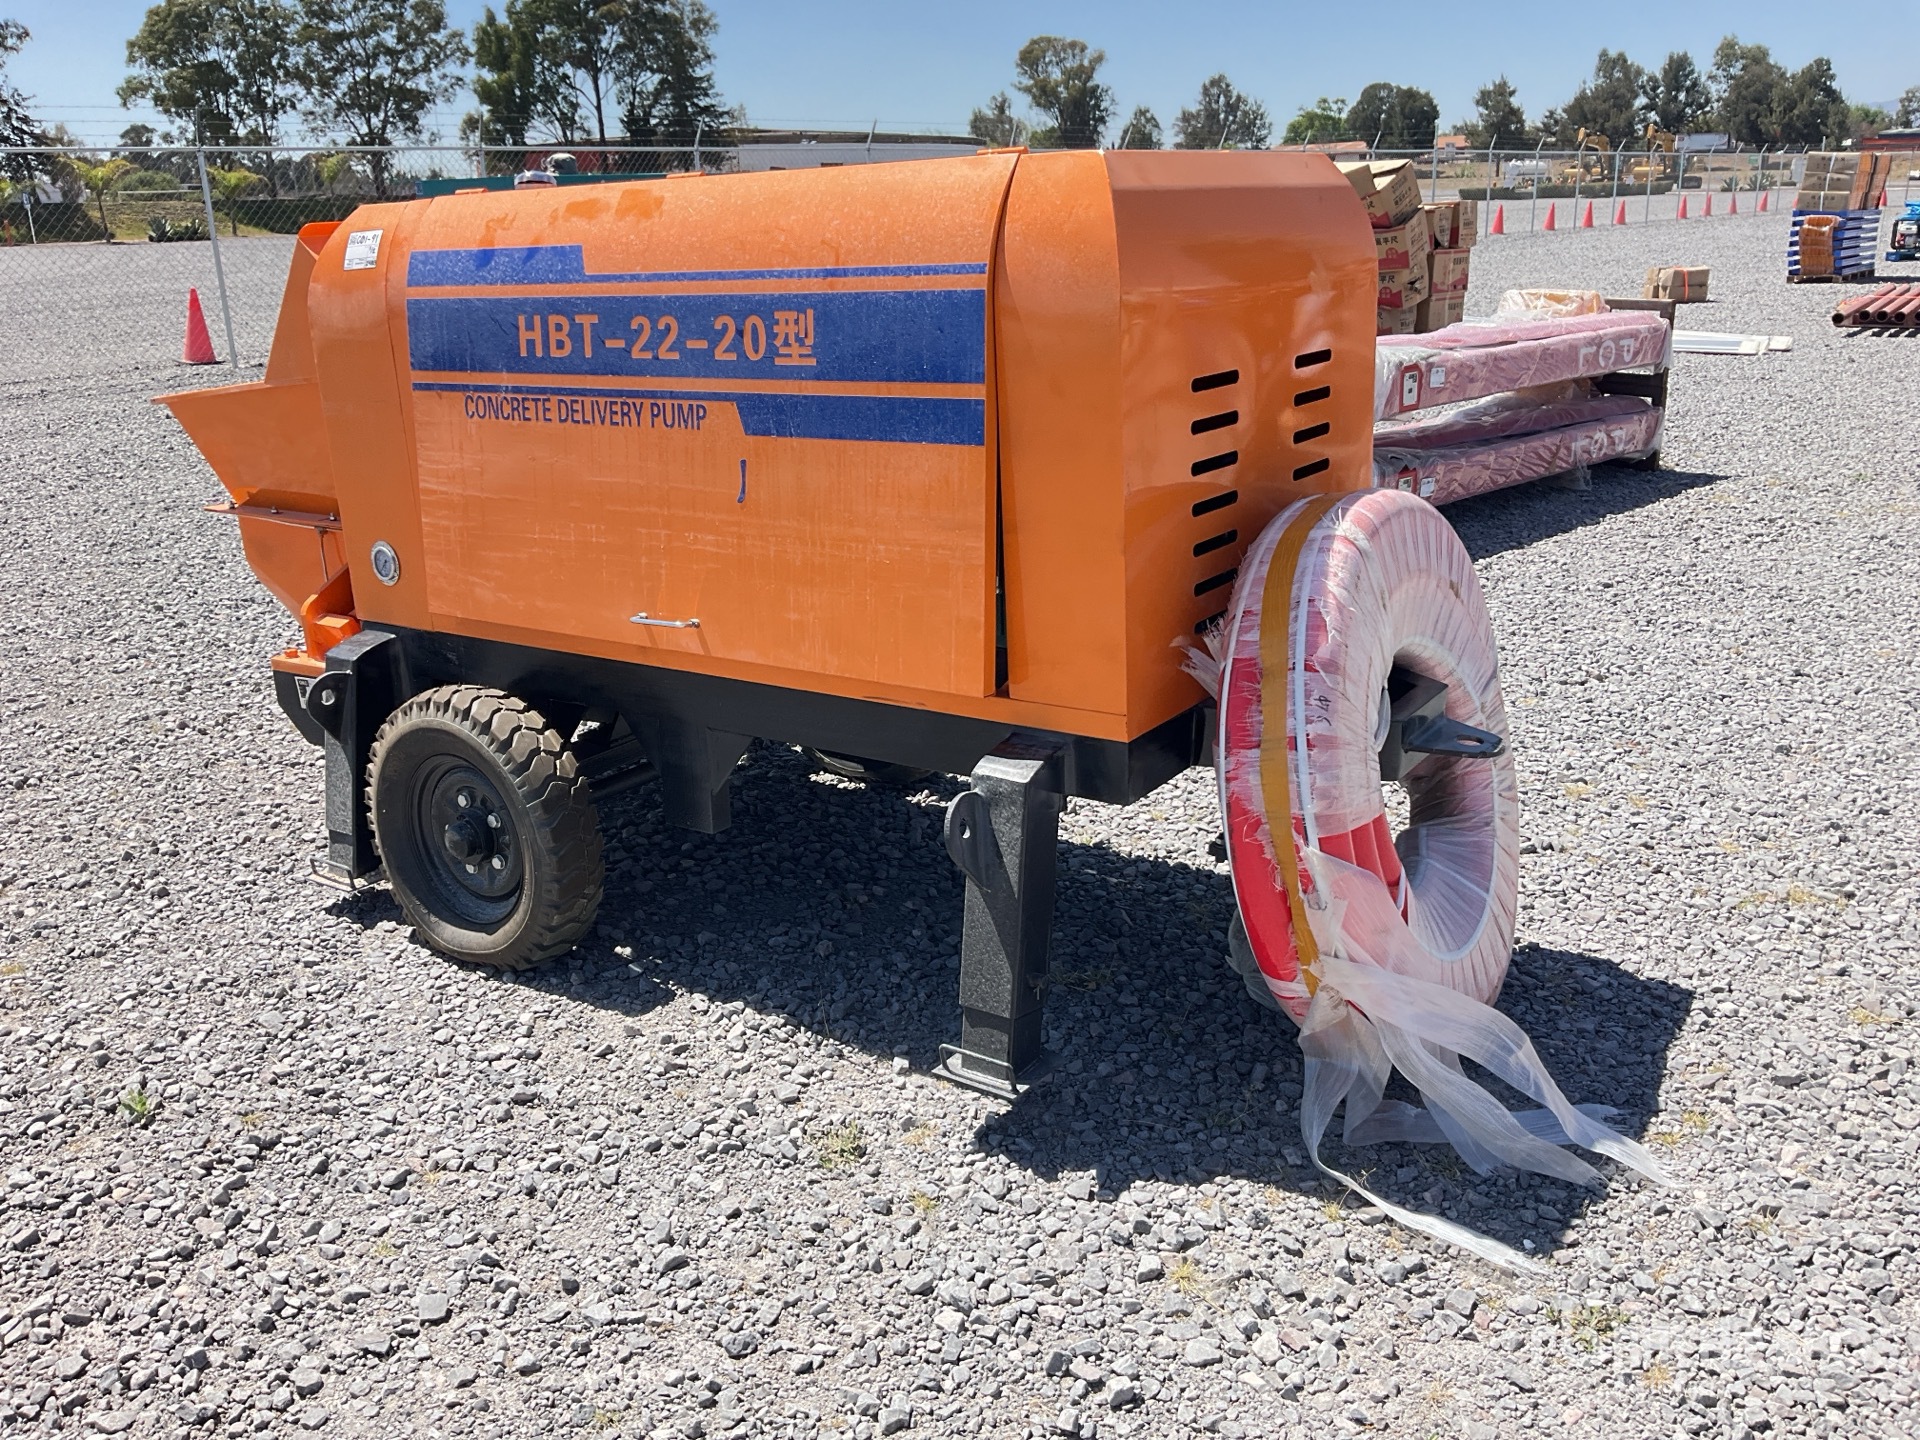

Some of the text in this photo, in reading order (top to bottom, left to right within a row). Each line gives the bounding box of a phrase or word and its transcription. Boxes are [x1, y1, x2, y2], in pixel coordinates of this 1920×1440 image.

[517, 308, 817, 366] HBT-22-20型
[464, 394, 708, 431] CONCRETE DELIVERY PUMP
